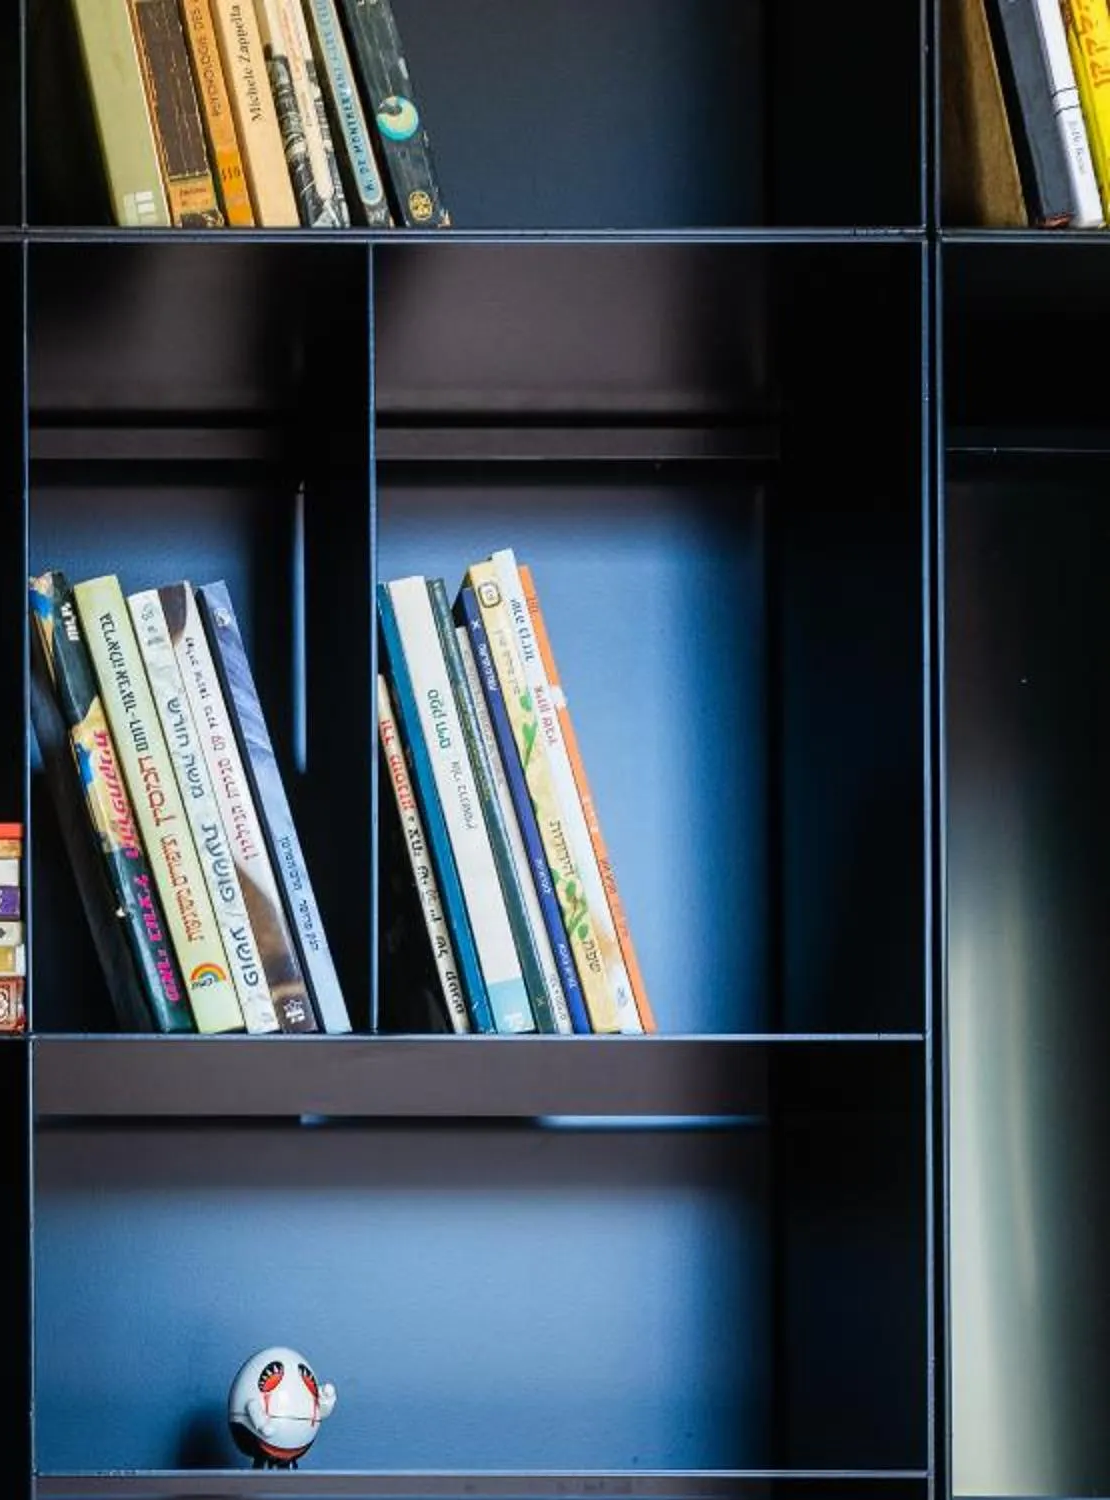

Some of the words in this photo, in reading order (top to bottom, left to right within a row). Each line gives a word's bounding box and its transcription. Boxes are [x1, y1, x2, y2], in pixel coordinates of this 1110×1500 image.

[232, 4, 252, 64] Zappella
[244, 66, 263, 121] Michele
[97, 612, 124, 668] גבריאלה
[425, 687, 445, 719] ספק
[135, 752, 174, 826] חמסין
[180, 752, 205, 800] משה
[200, 820, 239, 904] פושעת
[228, 924, 262, 989] פושע
[432, 933, 449, 958] של
